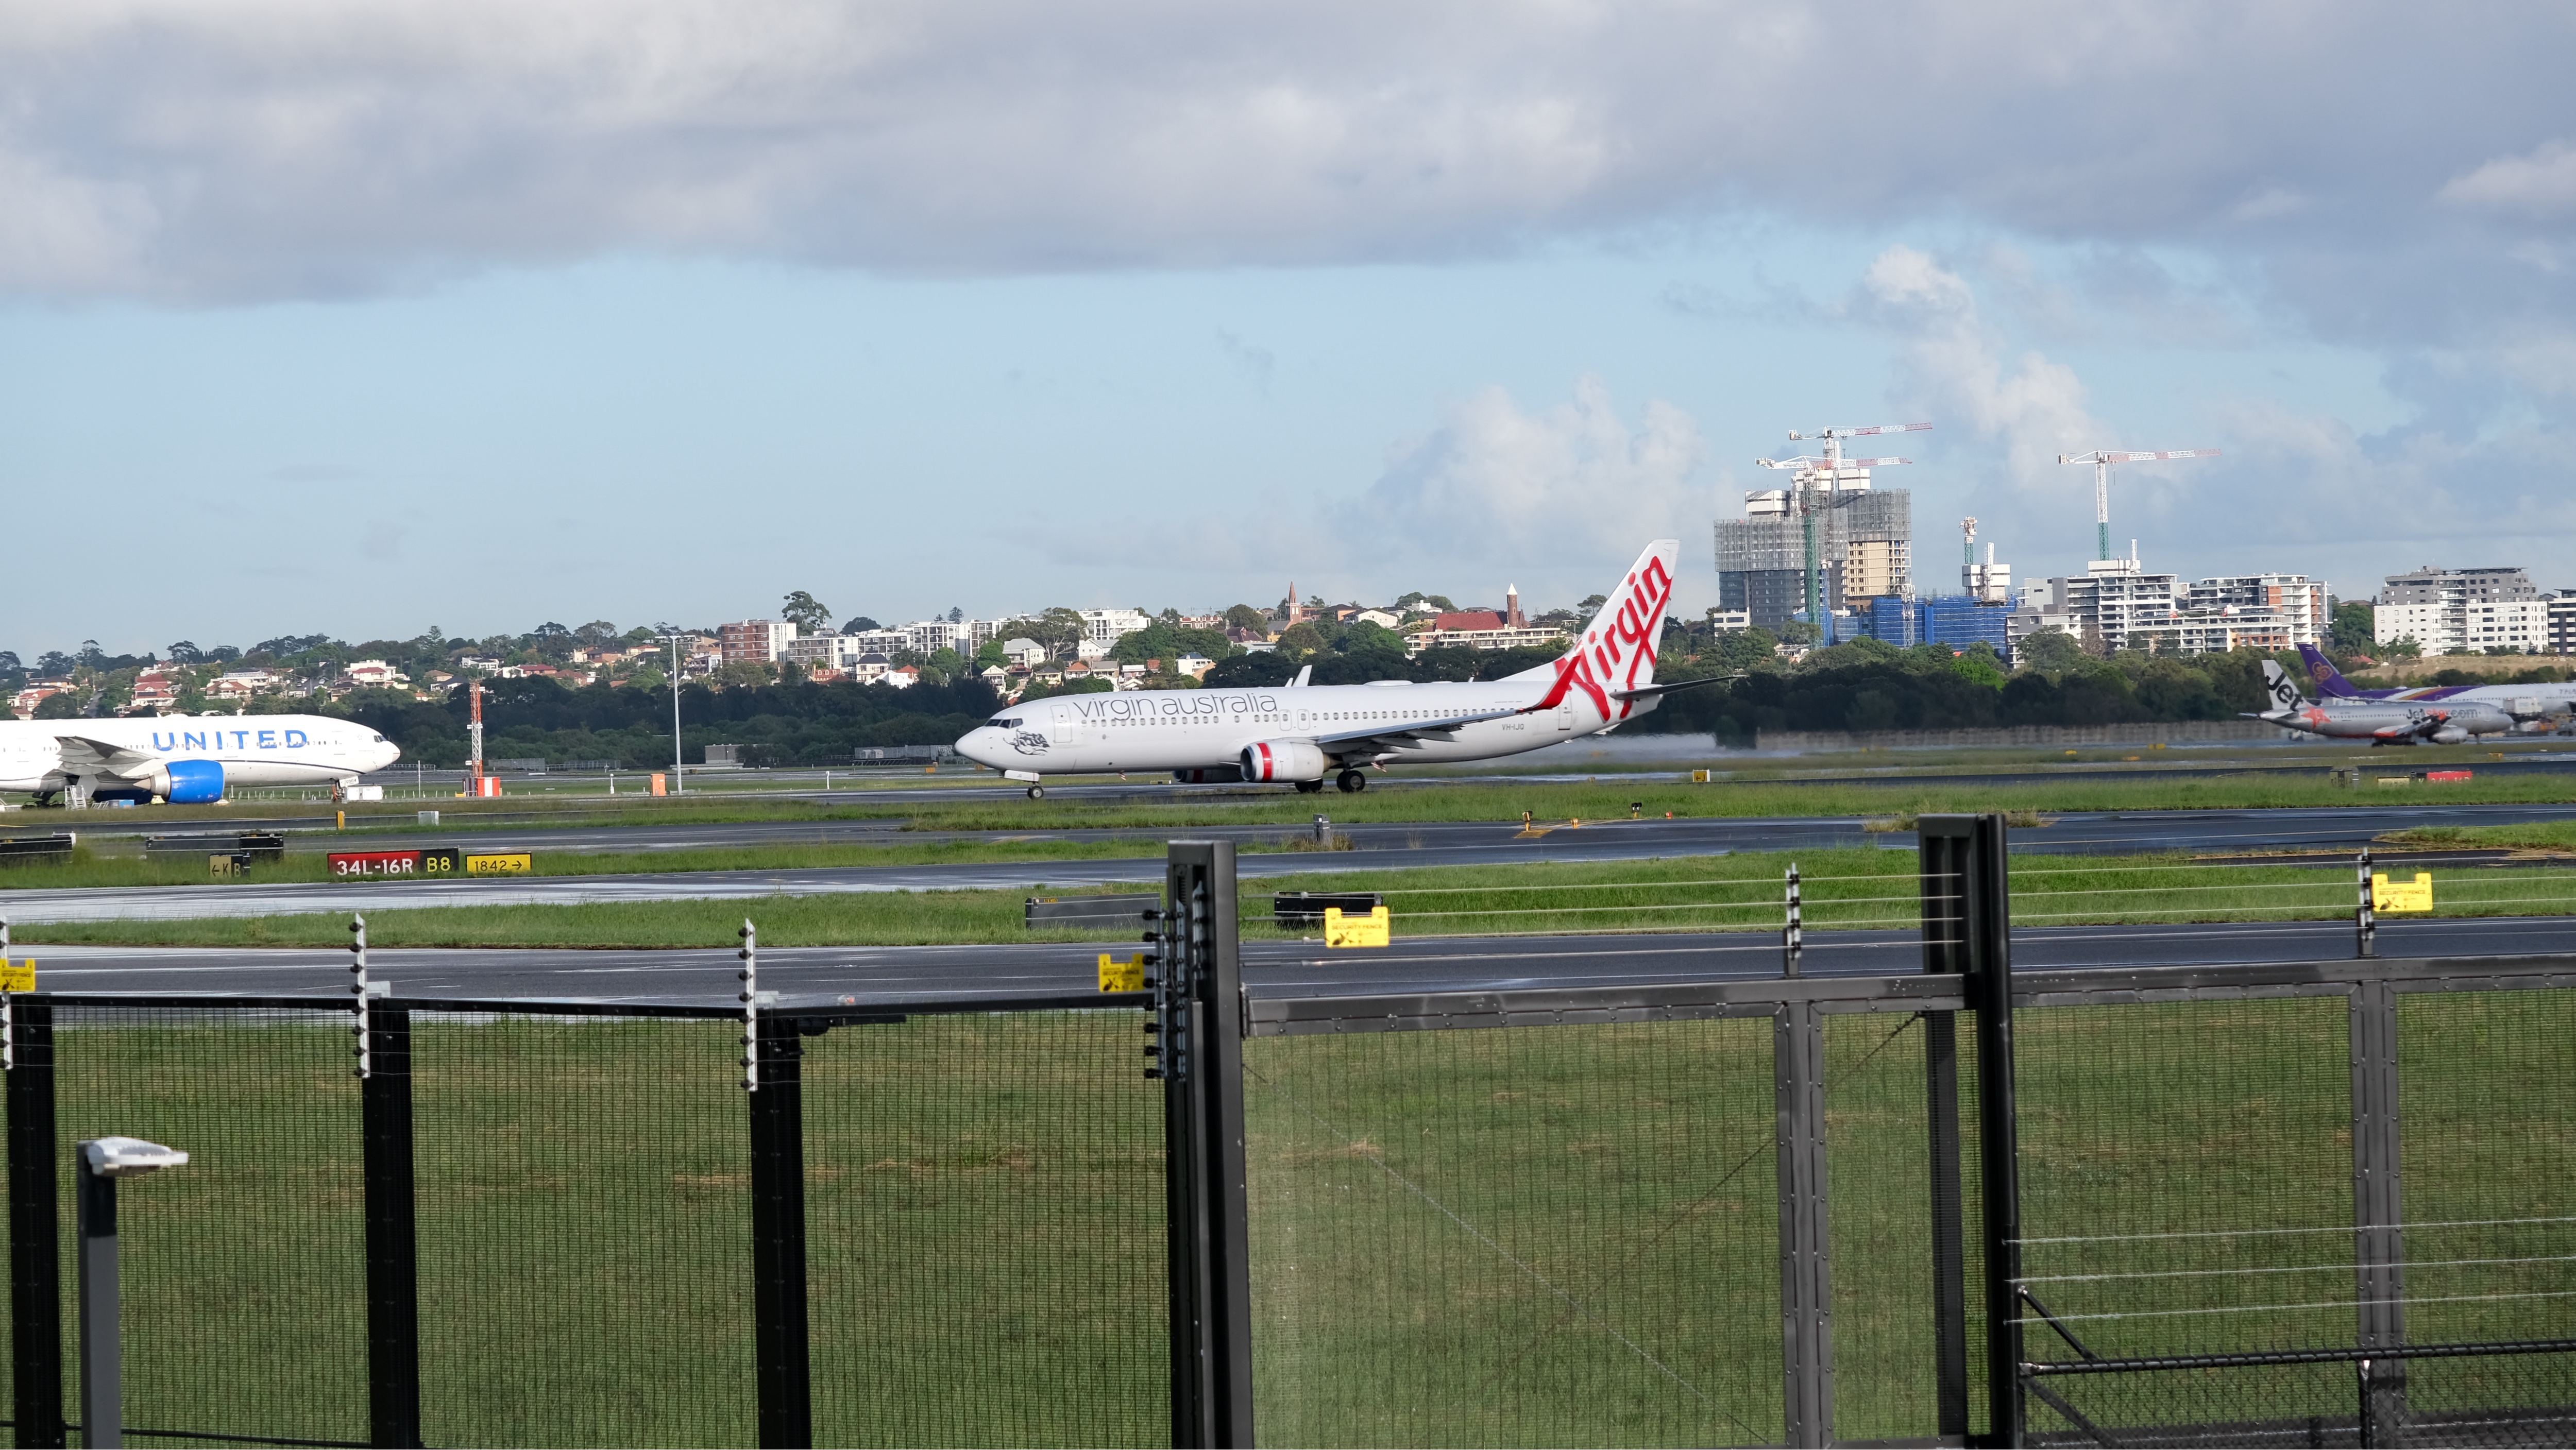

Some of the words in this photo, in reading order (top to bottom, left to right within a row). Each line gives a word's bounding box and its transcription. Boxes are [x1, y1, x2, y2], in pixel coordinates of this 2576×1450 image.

[1553, 556, 1673, 722] Virgin
[2266, 672, 2303, 712] Jet
[1073, 696, 1156, 721] virgin
[1162, 693, 1278, 715] australia
[2405, 708, 2478, 719] Jetstarcom
[152, 730, 308, 751] UNITED
[223, 863, 229, 877] K
[337, 858, 413, 876] 34L-16R
[427, 857, 450, 872] B8
[475, 860, 507, 872] 1842
